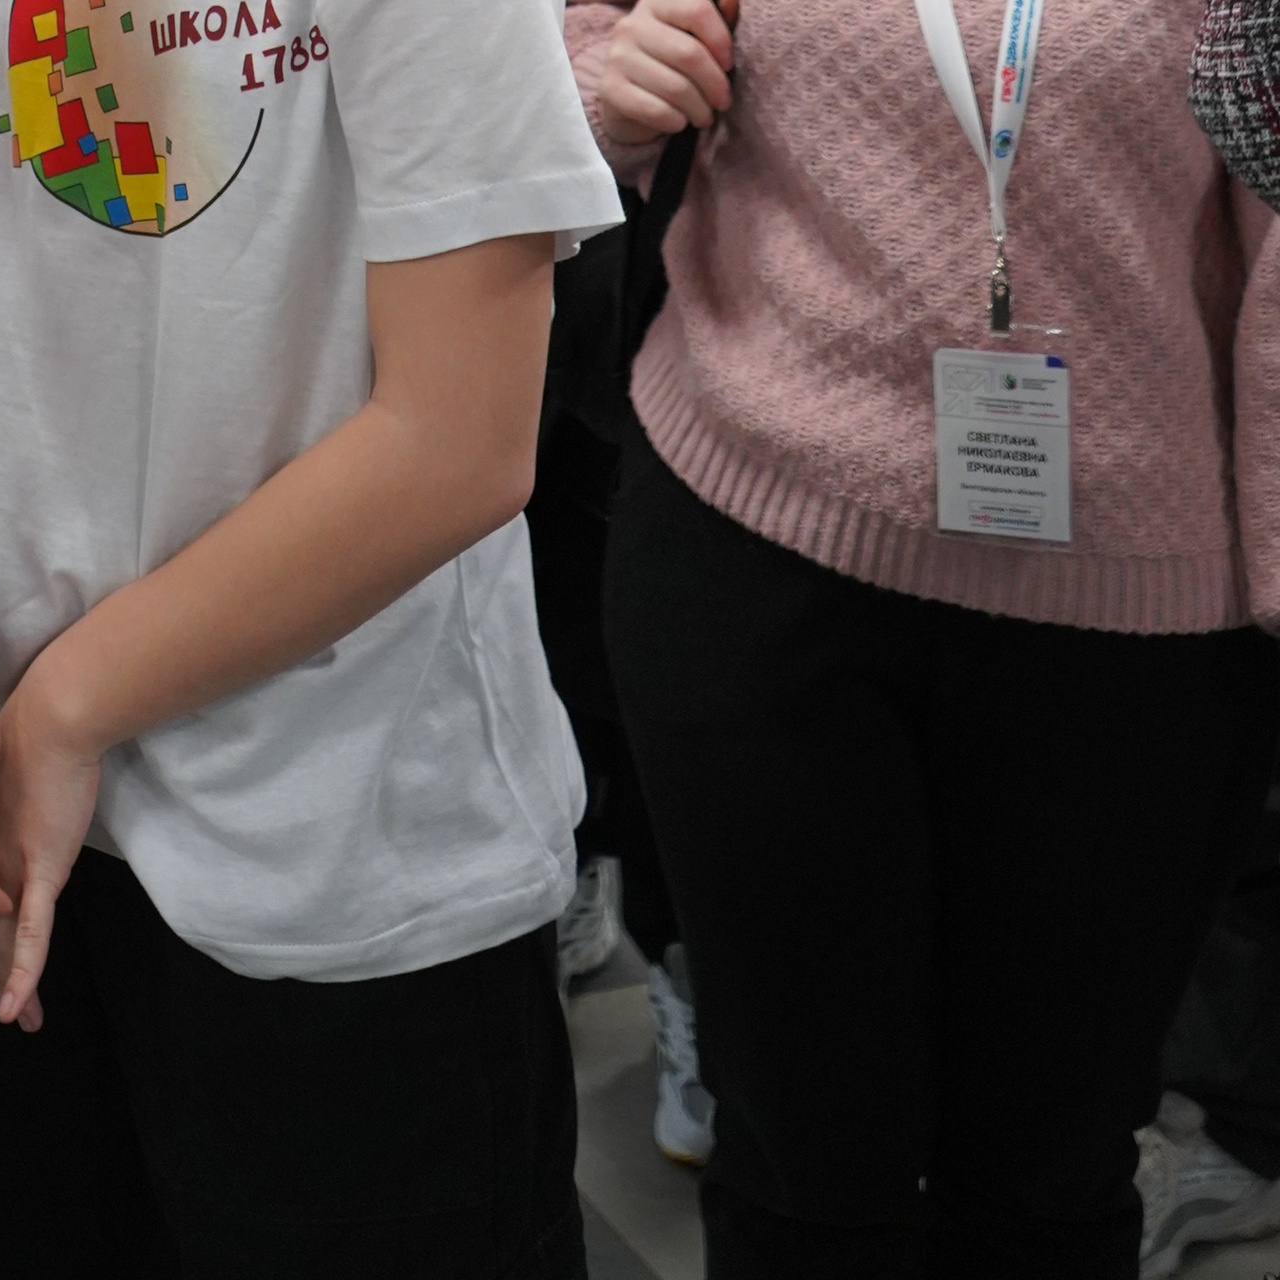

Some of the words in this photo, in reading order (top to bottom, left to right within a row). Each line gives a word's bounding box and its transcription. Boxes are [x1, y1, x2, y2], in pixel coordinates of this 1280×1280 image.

[240, 25, 329, 92] 1788
[966, 430, 1037, 448] СВЕТЛАНА
[957, 445, 1048, 464] НИКОЛАЕВНА
[966, 462, 1039, 478] ЕРМАКОВА
